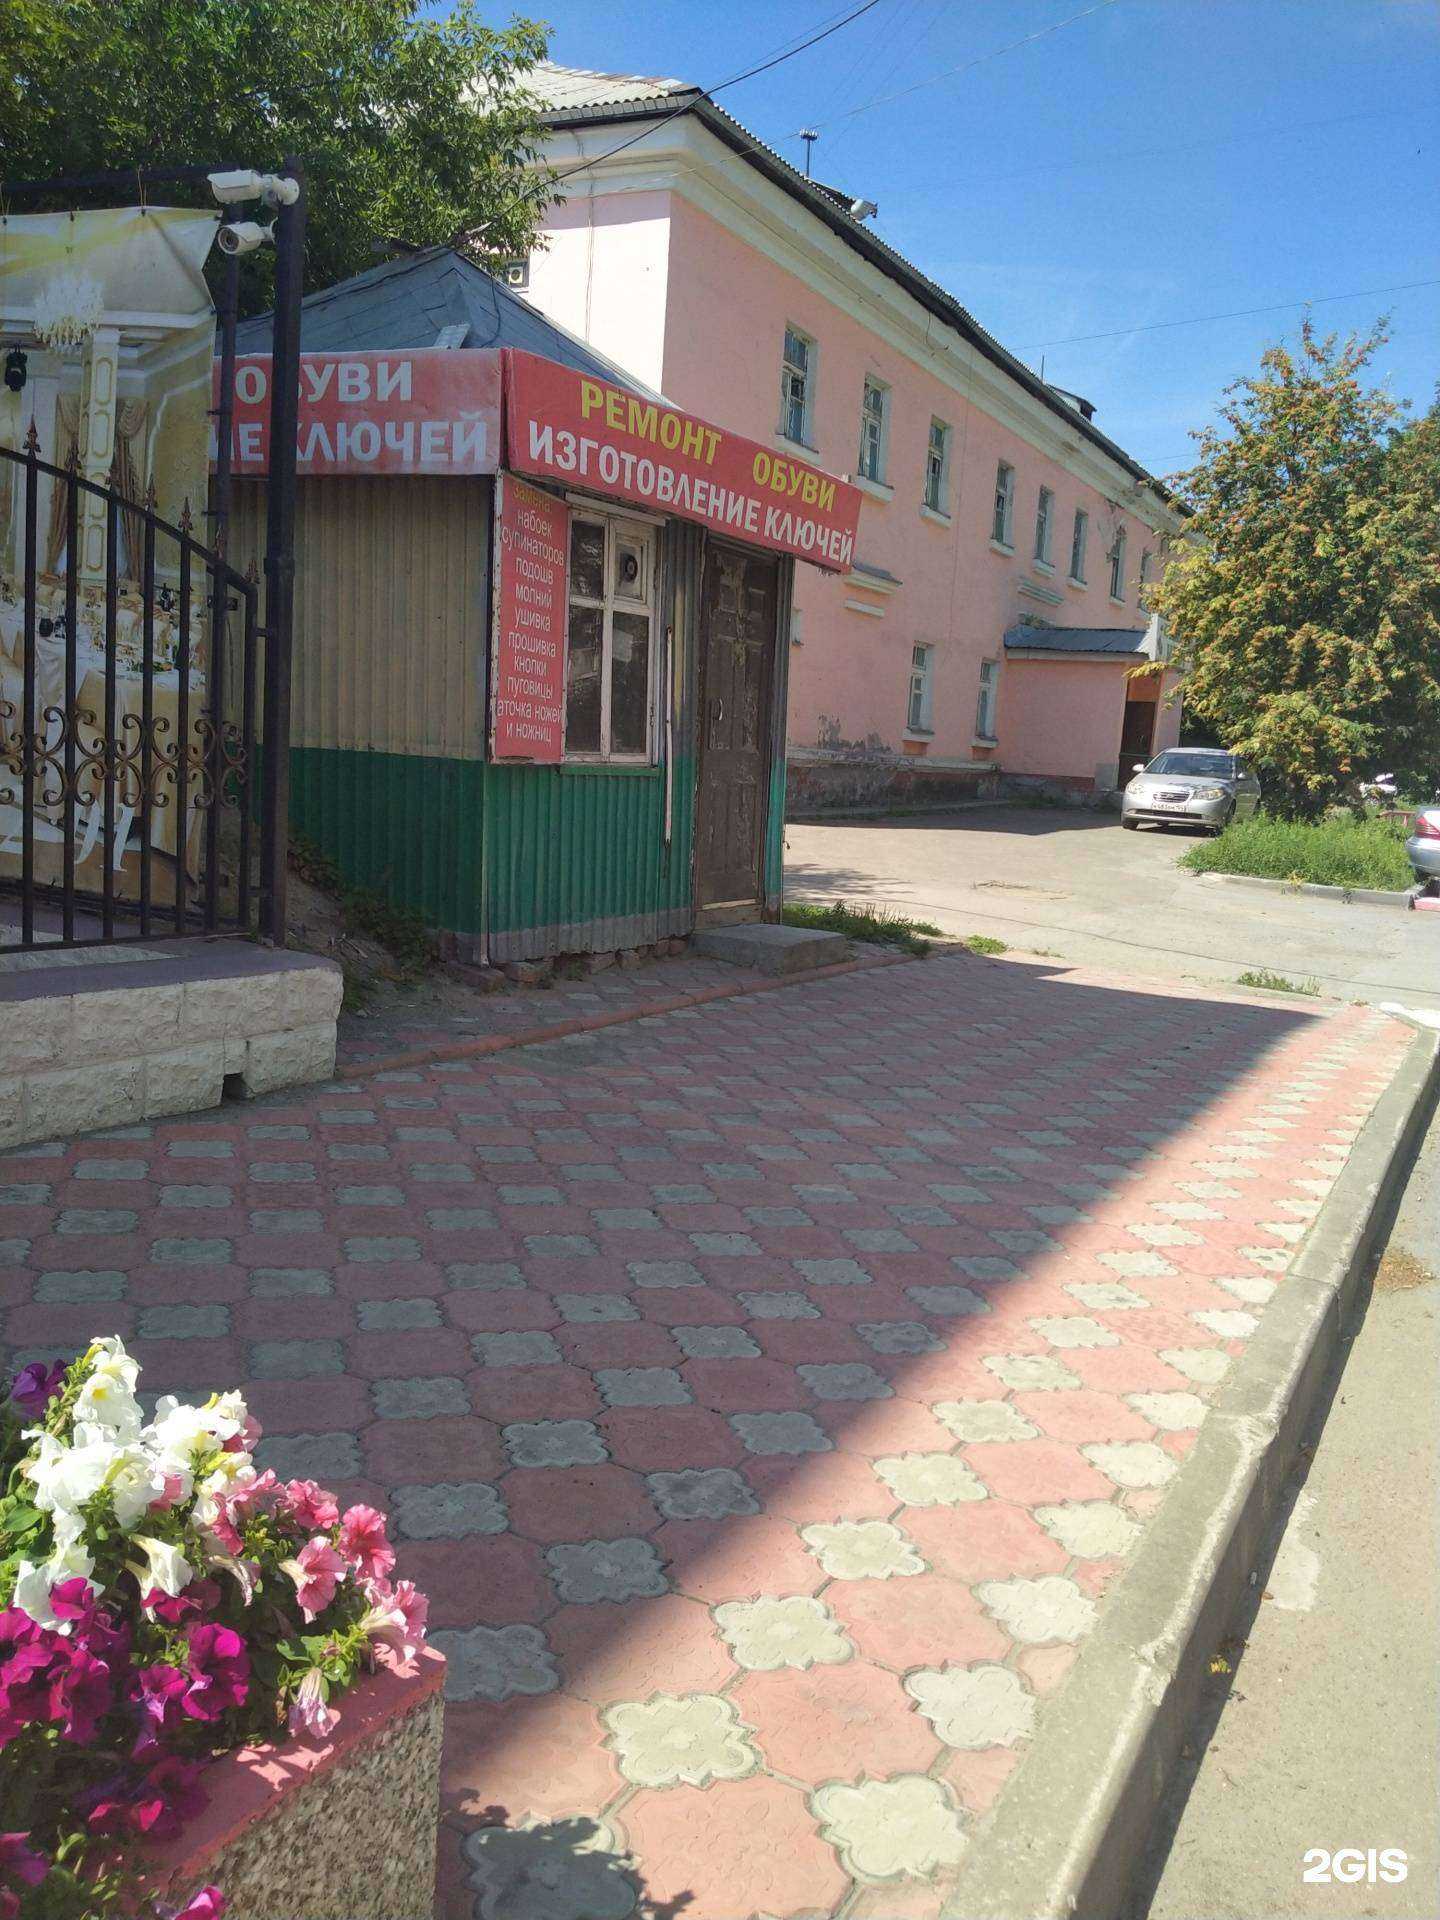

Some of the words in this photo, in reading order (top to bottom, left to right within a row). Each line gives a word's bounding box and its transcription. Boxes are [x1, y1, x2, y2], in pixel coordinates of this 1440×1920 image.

[235, 361, 412, 405] ОУВИ
[296, 411, 487, 462] ЛЮЧЕЙ
[580, 379, 723, 465] РЕМОНТ
[752, 451, 837, 513] ОБУВИ
[528, 419, 761, 534] ИЗГОТОВЛЕНИЕ
[764, 505, 854, 566] КЛЮЧЕЙ
[516, 510, 553, 539] набоек
[501, 526, 565, 566] супинаторов
[515, 557, 554, 585] подошв
[515, 583, 553, 609] молний
[514, 607, 551, 632] ушивка
[508, 631, 556, 658] прошивка
[513, 655, 548, 676] кнопки
[507, 676, 553, 703] пуговицы
[506, 723, 513, 737] и
[516, 722, 552, 748] ножниц
